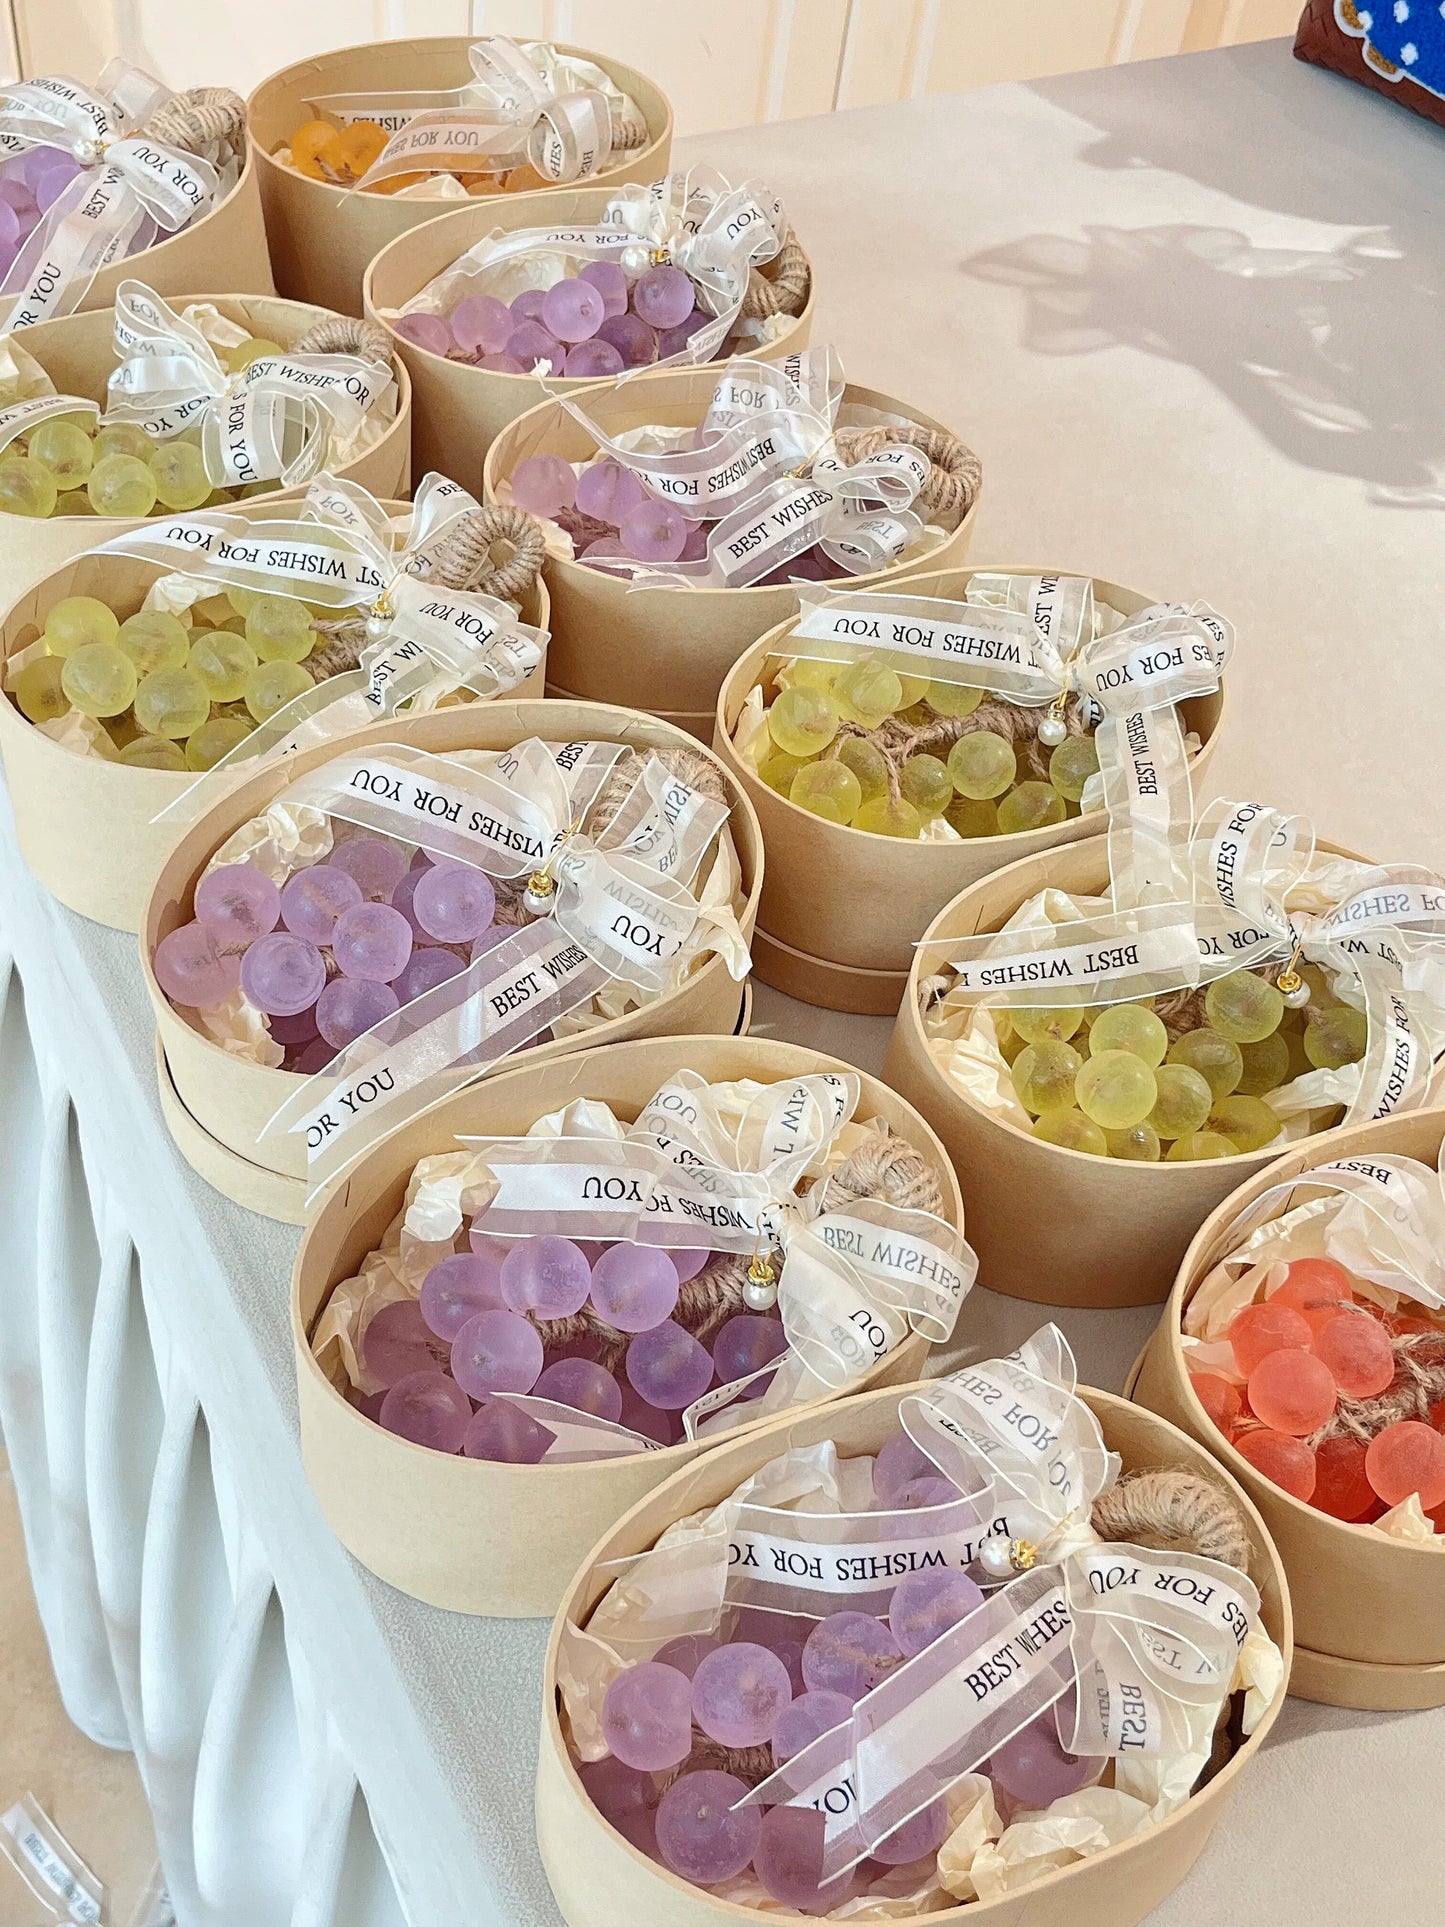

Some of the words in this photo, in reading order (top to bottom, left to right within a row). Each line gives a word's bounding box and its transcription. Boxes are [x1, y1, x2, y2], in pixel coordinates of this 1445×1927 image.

[77, 101, 108, 136] BEST
[132, 146, 167, 173] YOU
[171, 170, 204, 206] FOR
[81, 189, 111, 220] BEST
[545, 232, 586, 243] YOU
[595, 232, 629, 244] FOR
[725, 207, 763, 240] YOU
[30, 262, 61, 304] YOU
[13, 310, 39, 329] OR
[344, 376, 370, 406] OR
[143, 417, 173, 433] YO
[228, 403, 245, 435] FOR
[230, 440, 258, 482] YOU
[749, 438, 776, 465] BEST
[659, 478, 699, 495] FOR
[708, 450, 751, 493] WISHES
[166, 526, 215, 551] YOU
[728, 522, 772, 559] BEST
[771, 488, 834, 527] WISHES
[219, 540, 261, 563] FOR
[267, 550, 347, 580] WISHES
[419, 602, 456, 621] YOU
[1034, 602, 1052, 635] EST
[455, 611, 494, 646] FOR
[833, 618, 881, 638] YOU
[892, 624, 935, 648] FOR
[943, 633, 1021, 663] WISHES
[1138, 646, 1183, 675] FOR
[365, 661, 396, 705] BEST
[1096, 667, 1134, 691] YOU
[1126, 712, 1150, 759] WISHES
[350, 769, 404, 802] YOU
[1139, 760, 1158, 795] BEST
[414, 788, 463, 823] FOR
[610, 914, 666, 957] YOU
[1197, 937, 1225, 956] YO
[981, 959, 1074, 987] WISHES
[1084, 945, 1140, 974] BEST
[489, 972, 544, 1018] BEST
[540, 944, 588, 981] WISHES
[1390, 995, 1412, 1034] FOR
[1372, 1039, 1410, 1120] WISHES
[306, 1113, 339, 1148] OR
[338, 1067, 395, 1114] YOU
[1328, 1161, 1392, 1185] BEST
[582, 1177, 644, 1201] YOU
[646, 1195, 674, 1213] FO
[679, 1197, 754, 1229] WISHES
[728, 1543, 760, 1568] YO
[770, 1547, 824, 1579] FOR
[837, 1550, 948, 1581] WISHES
[1089, 1566, 1141, 1594] YOU
[1154, 1573, 1216, 1606] FOR
[963, 1644, 1021, 1701] BEST
